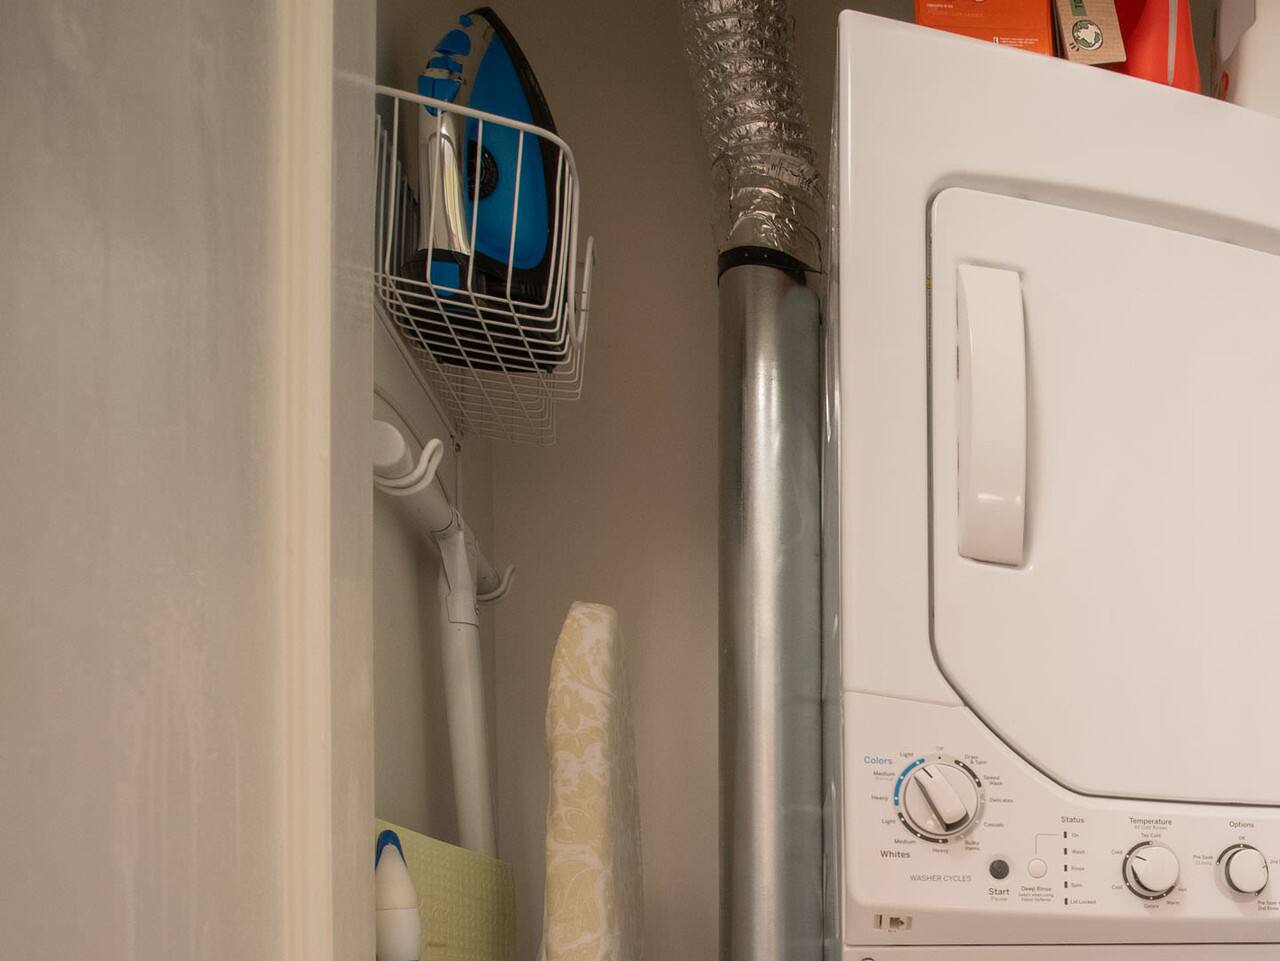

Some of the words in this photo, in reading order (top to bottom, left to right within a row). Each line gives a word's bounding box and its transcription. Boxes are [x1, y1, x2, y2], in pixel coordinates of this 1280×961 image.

[864, 756, 893, 764] Colors
[1129, 817, 1172, 826] Temperature
[1229, 820, 1254, 828] Options
[880, 850, 911, 858] Whites
[988, 887, 1010, 895] Start
